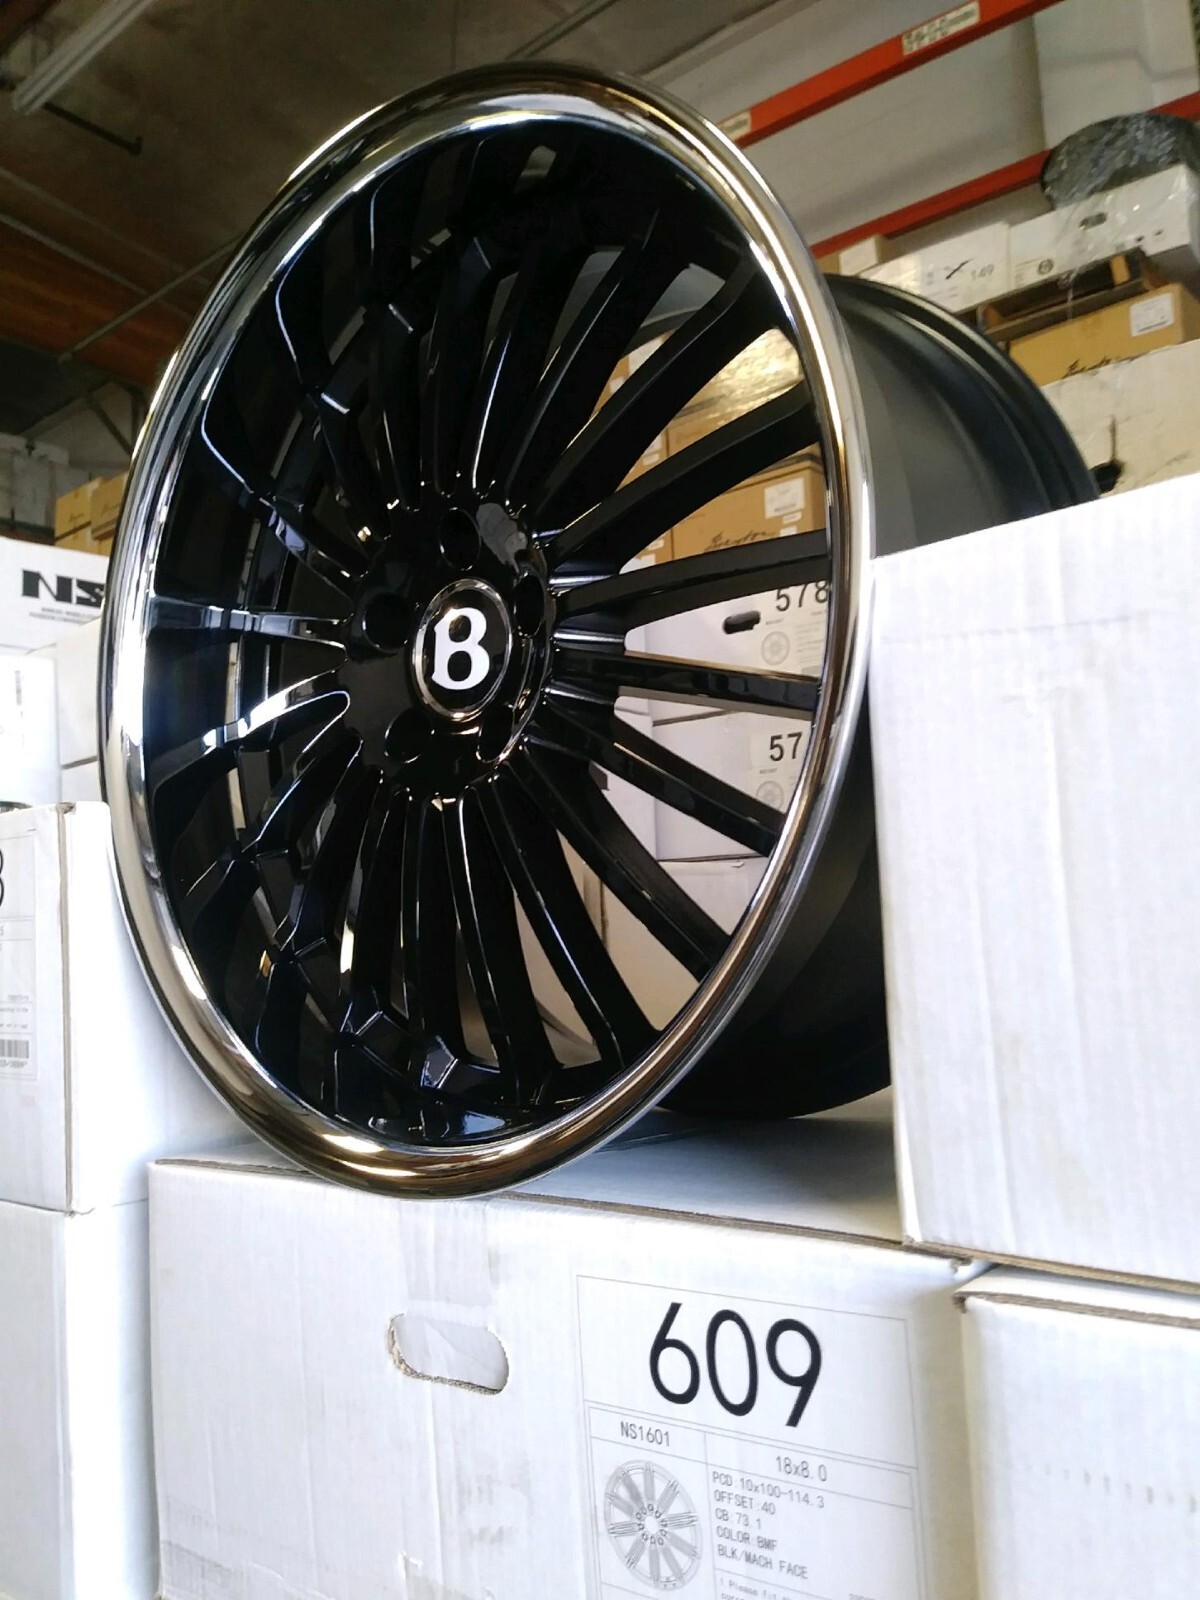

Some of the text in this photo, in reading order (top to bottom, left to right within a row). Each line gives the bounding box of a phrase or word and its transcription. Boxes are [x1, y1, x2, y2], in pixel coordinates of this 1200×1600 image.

[431, 607, 490, 690] B
[650, 1302, 822, 1428] 609
[620, 1421, 670, 1447] NS1601
[717, 1544, 809, 1579] BLK/MACH FACE
